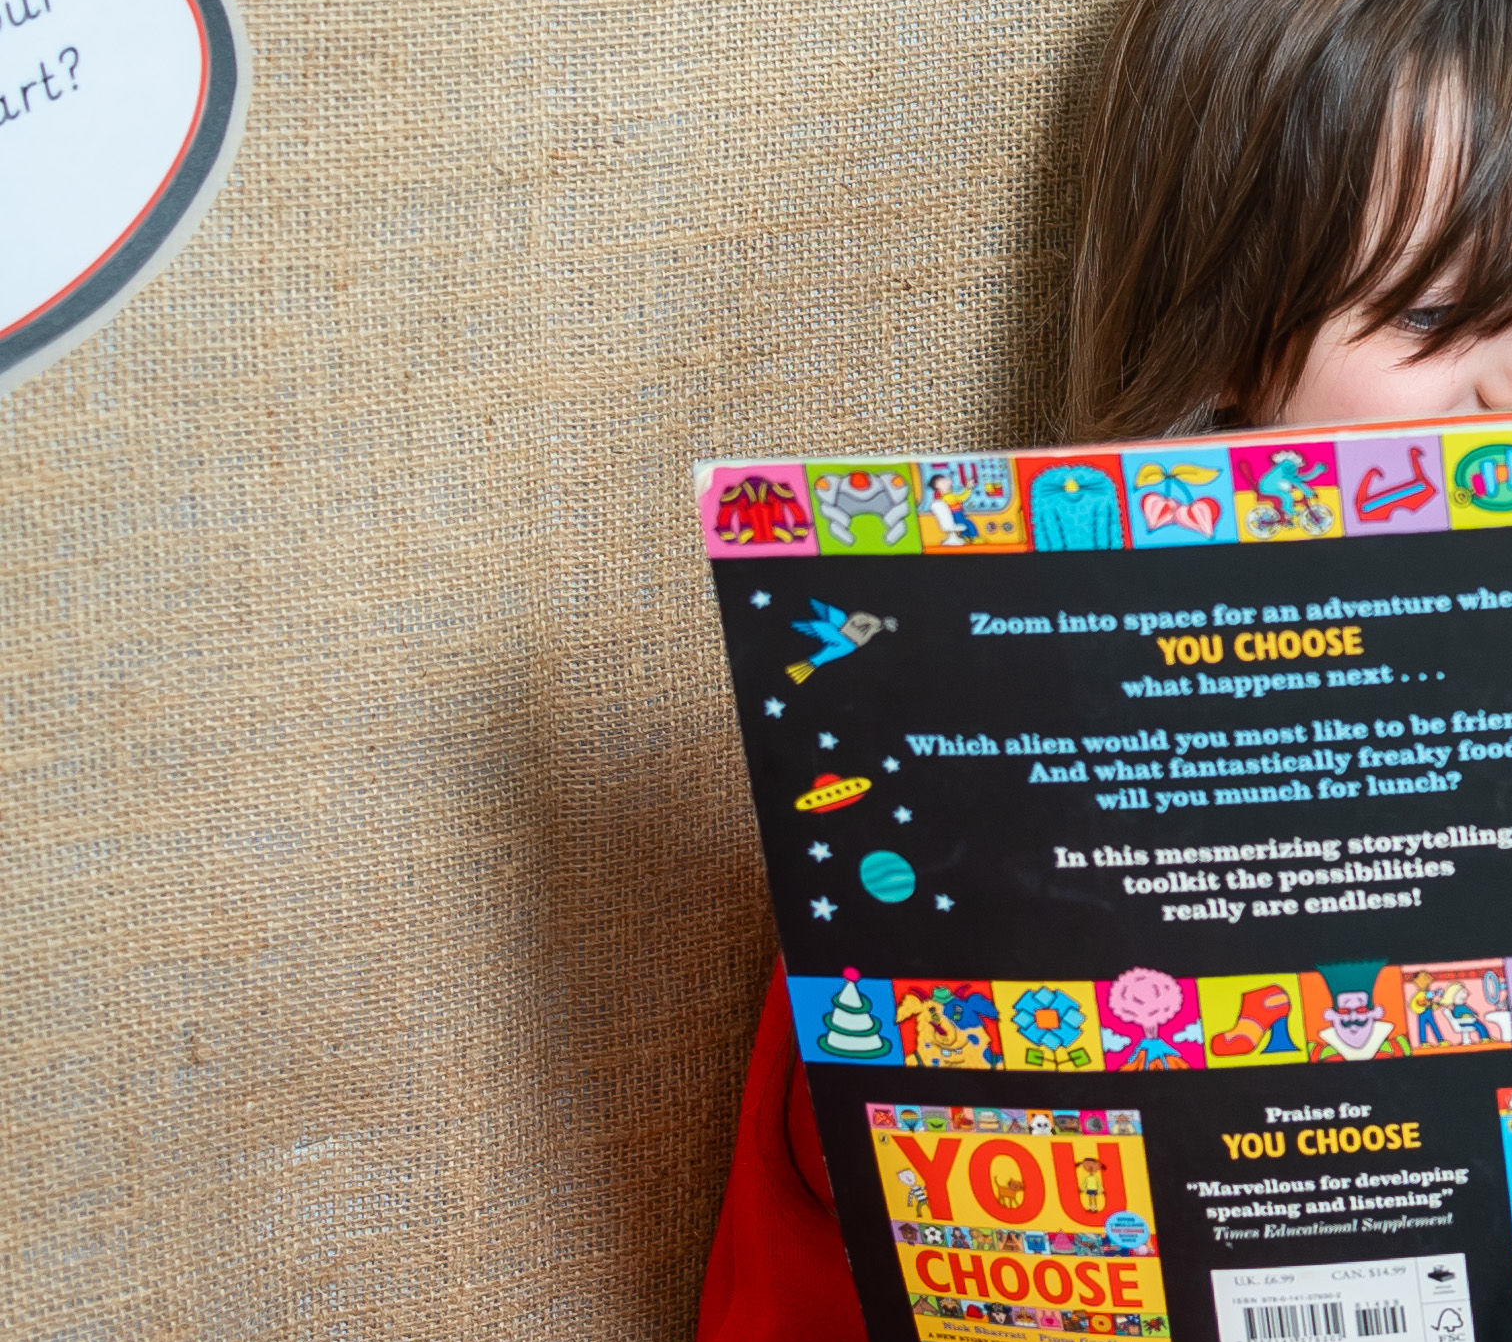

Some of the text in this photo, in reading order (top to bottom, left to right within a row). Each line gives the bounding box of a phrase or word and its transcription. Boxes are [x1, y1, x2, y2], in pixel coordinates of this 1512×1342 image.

[970, 612, 1054, 636] Zoom
[1057, 610, 1118, 634] into
[1123, 610, 1207, 636] space
[1210, 603, 1257, 628] for
[1262, 604, 1302, 624] an
[1305, 594, 1452, 621] adventure
[1156, 625, 1364, 666] YOU CHOOSE
[1121, 664, 1394, 699] what happens next
[1053, 846, 1089, 869] In
[1092, 843, 1150, 867] this
[1155, 837, 1341, 866] mesmerizing
[1122, 857, 1456, 895] toolkit the possibilities
[1161, 888, 1423, 924] really are endless!
[1265, 1102, 1372, 1124] Praise for
[1221, 1122, 1422, 1160] YOU CHOOSE
[891, 1135, 1128, 1227] YOU
[1186, 1166, 1469, 1198] “Marvellous for developing
[1206, 1188, 1453, 1223] speaking and listening”
[915, 1249, 1143, 1308] CHOOSE
